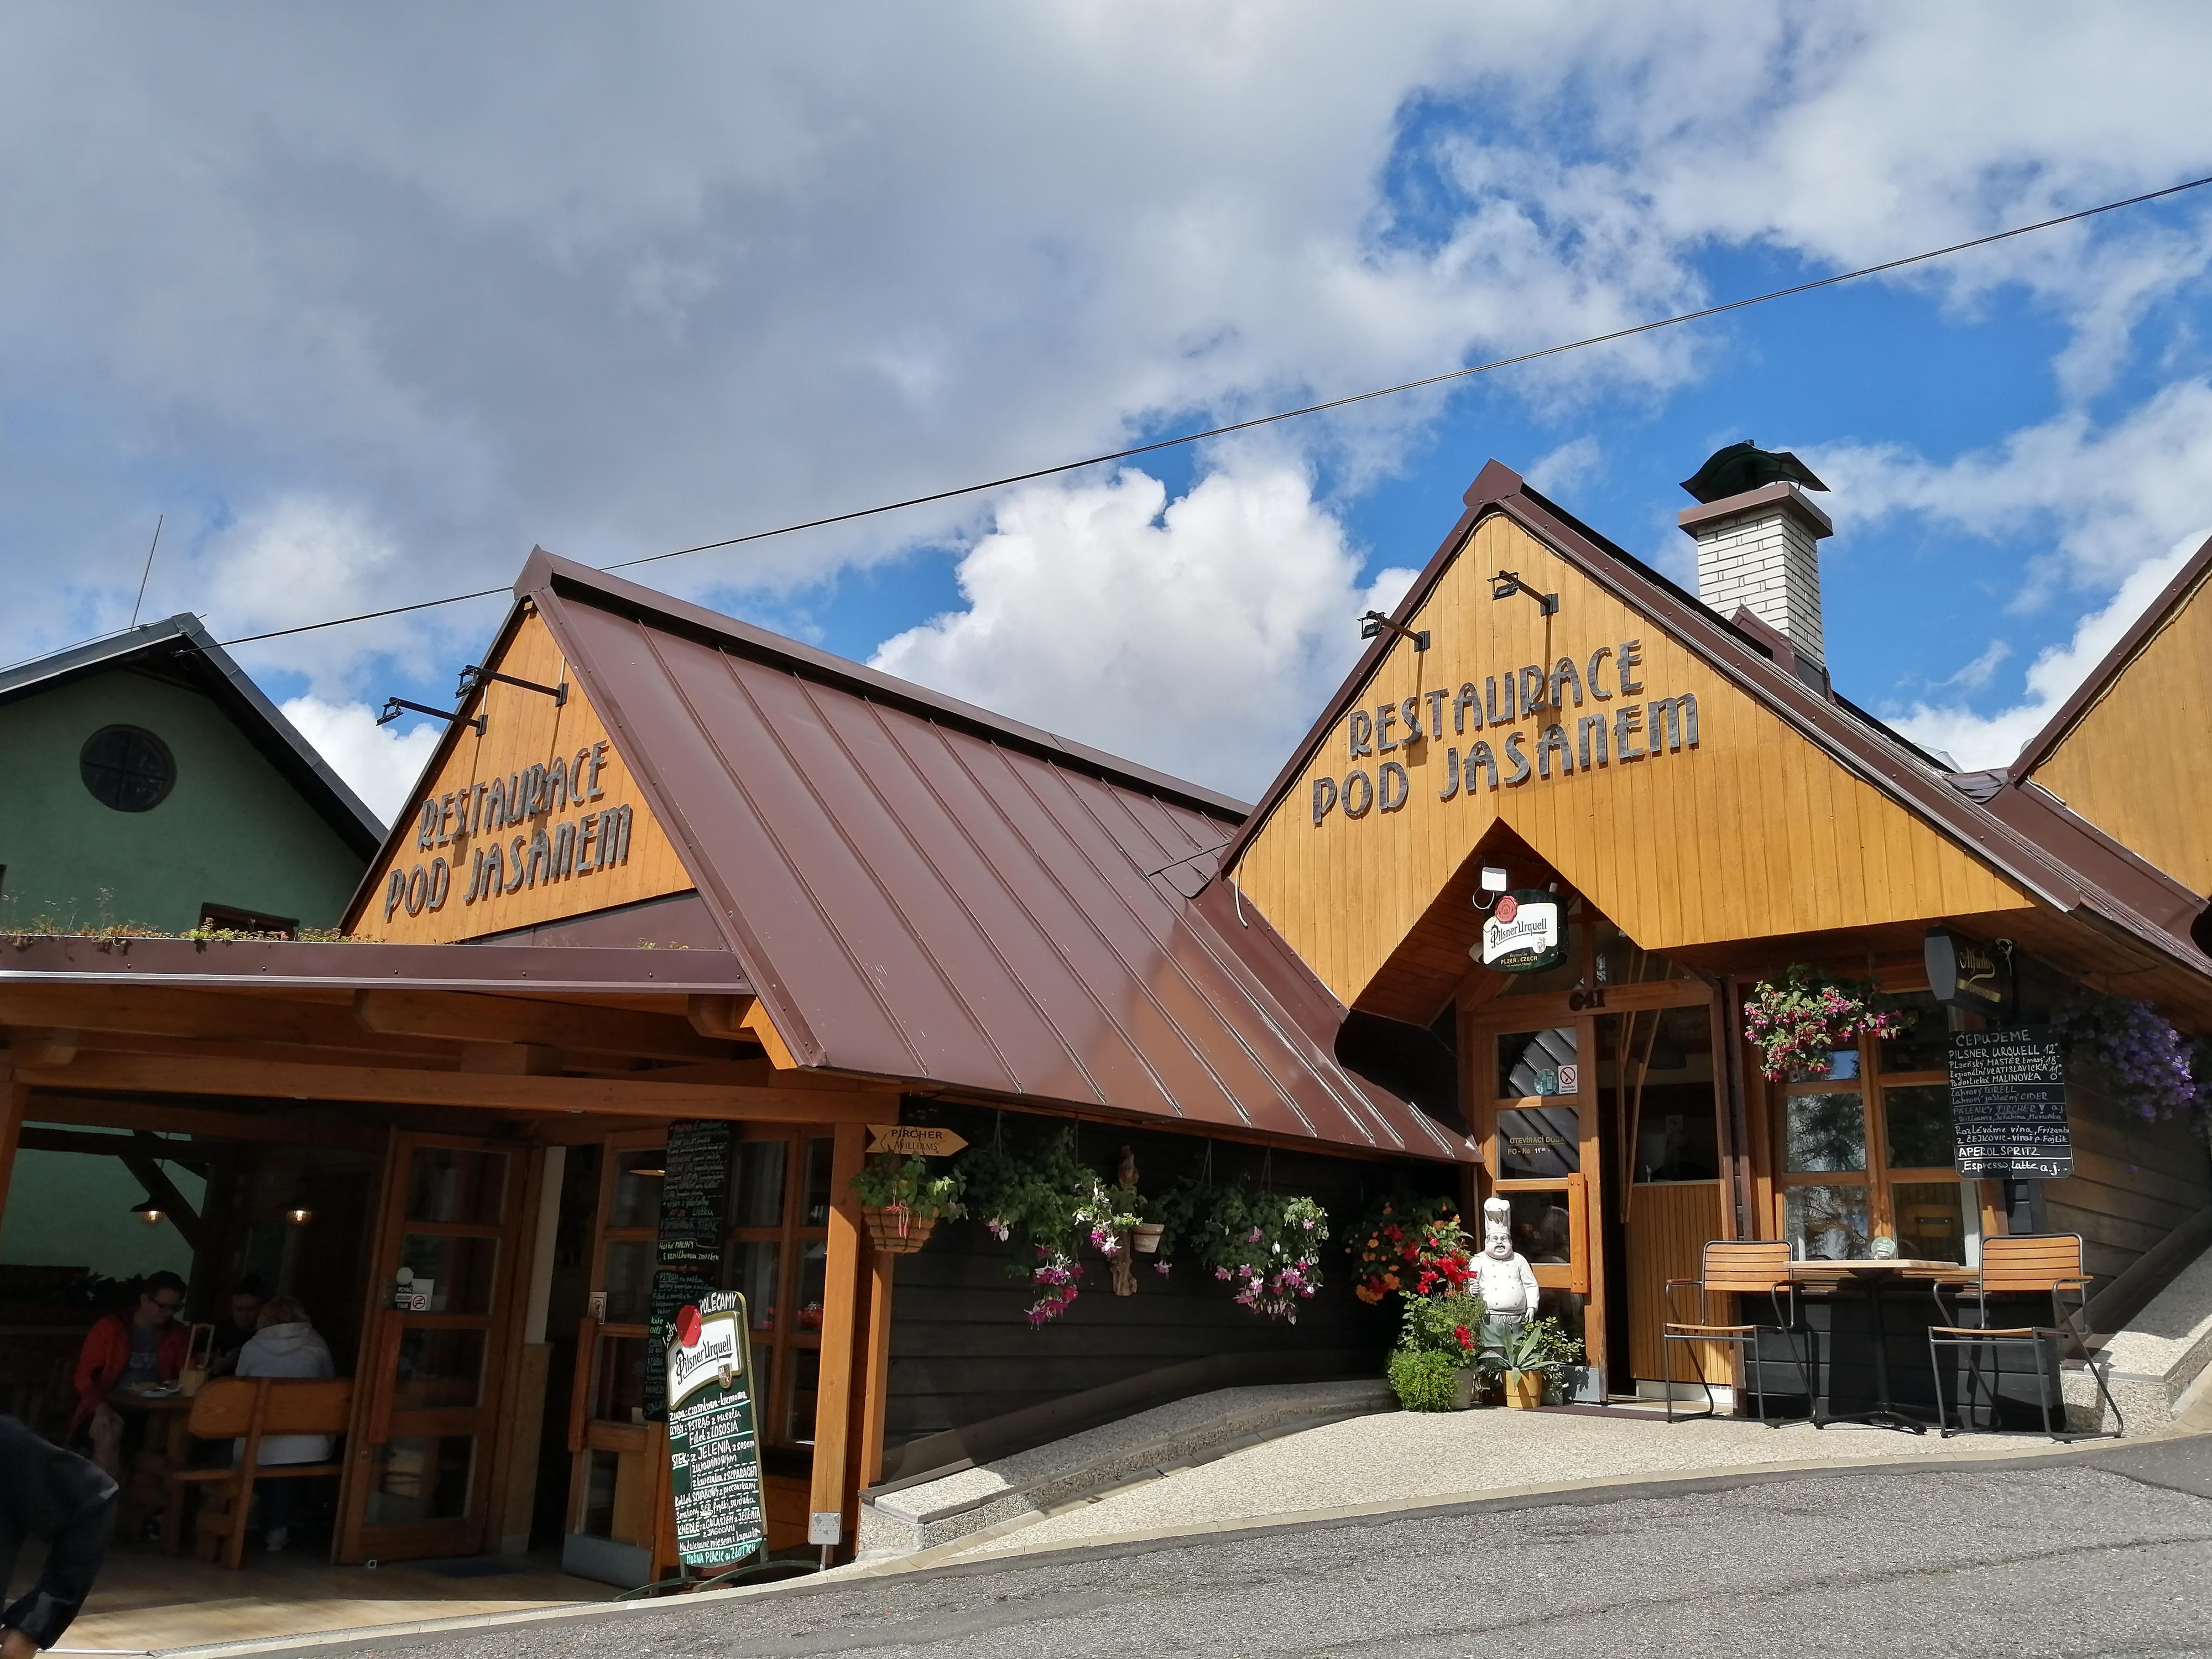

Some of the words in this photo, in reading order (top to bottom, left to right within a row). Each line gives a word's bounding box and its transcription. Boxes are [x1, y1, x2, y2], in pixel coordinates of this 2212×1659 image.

[1348, 638, 1645, 758] RESTAURACE
[1312, 761, 1410, 825] POD
[1438, 693, 1700, 799] JASANEM
[418, 740, 609, 848] RESTAURACE
[385, 857, 449, 920] POD
[463, 804, 632, 902] JASANEM
[1490, 925, 1518, 949] Pilsner
[1517, 918, 1547, 936] Urquell
[1948, 1048, 1990, 1059] PILSNER
[1992, 1045, 2039, 1058] URQUELL
[1987, 1057, 2020, 1066] MASTER
[2021, 1092, 2048, 1100] CIDER
[891, 1129, 942, 1139] PIRCHER
[1510, 1135, 1543, 1144] OTEVÍRACÍ
[894, 1141, 938, 1151] WILLIAMS
[1959, 1147, 2000, 1157] APEROL
[2001, 1147, 2041, 1156] SPRITZ
[698, 1292, 737, 1315] POLECAMY
[676, 1348, 704, 1385] Pilsner
[703, 1334, 732, 1363] Urquell
[698, 1439, 732, 1460] JELENIA
